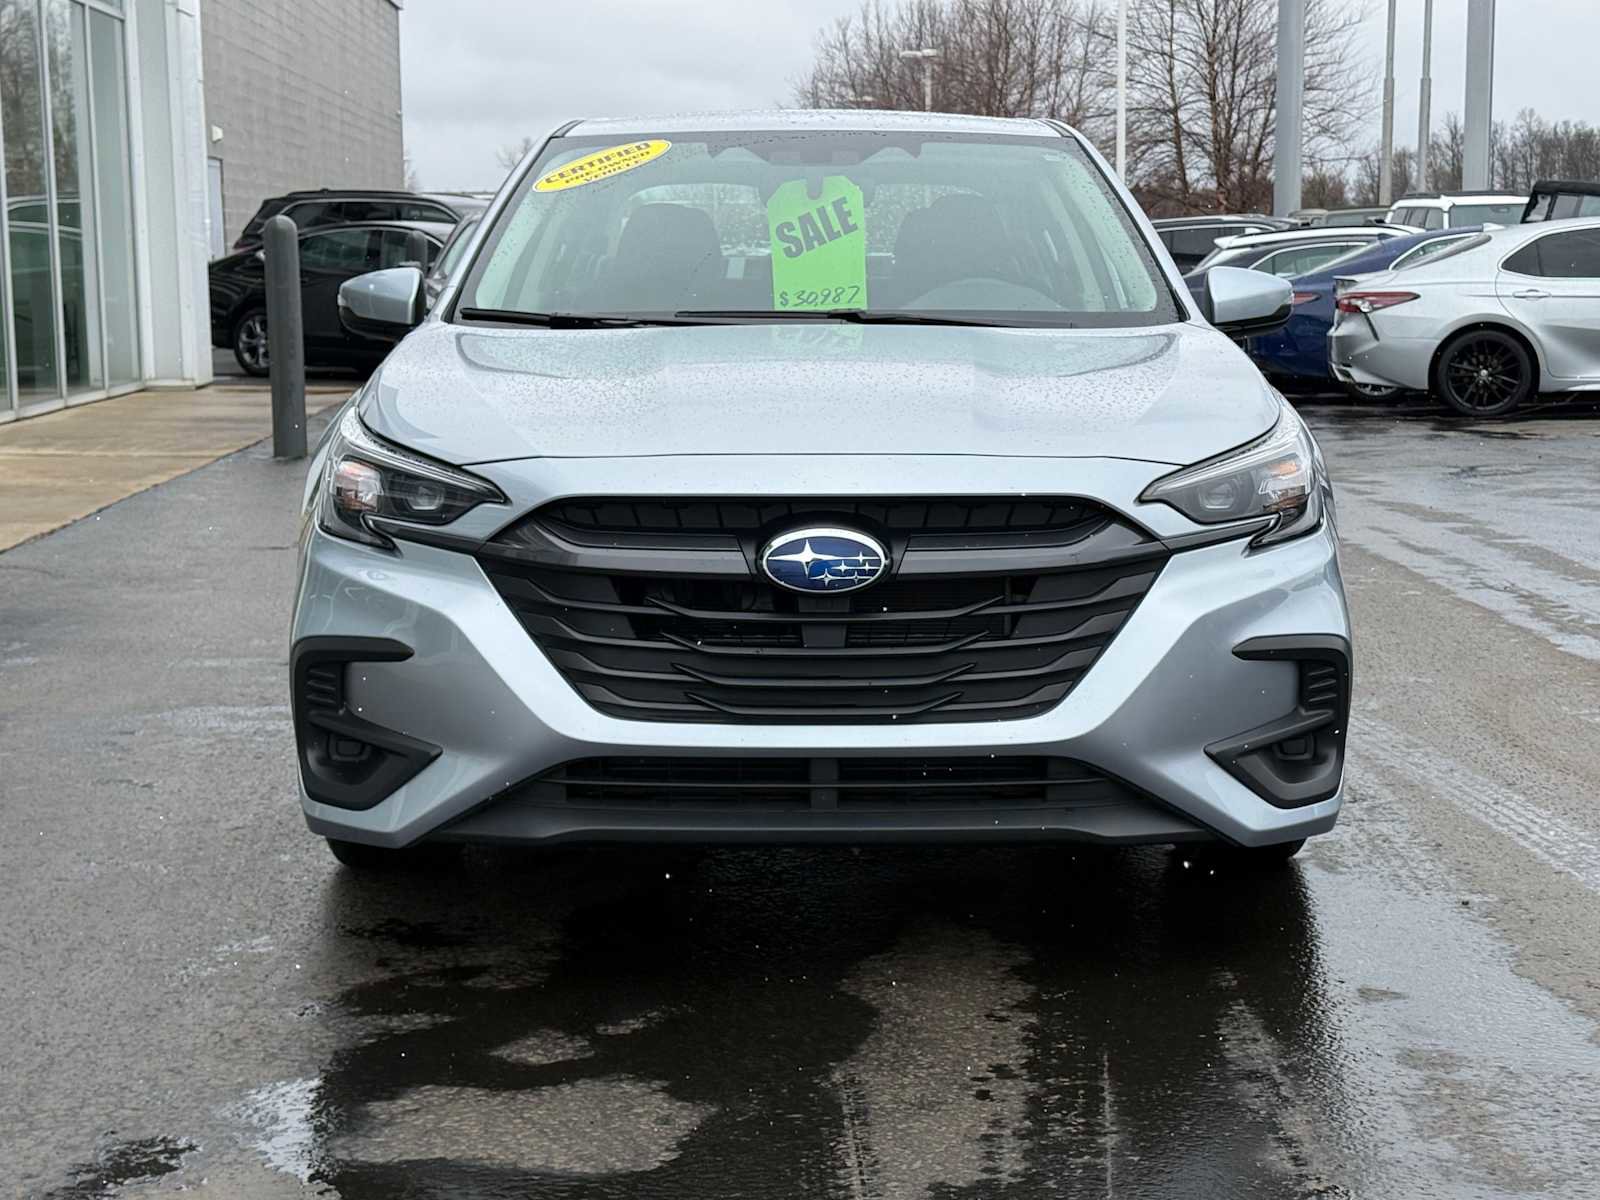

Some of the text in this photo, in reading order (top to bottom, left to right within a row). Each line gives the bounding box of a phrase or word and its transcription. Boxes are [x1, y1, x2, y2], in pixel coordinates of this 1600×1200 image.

[545, 142, 651, 184] CERTIFIED
[583, 160, 640, 182] VEHICLE
[775, 196, 859, 259] SALE
